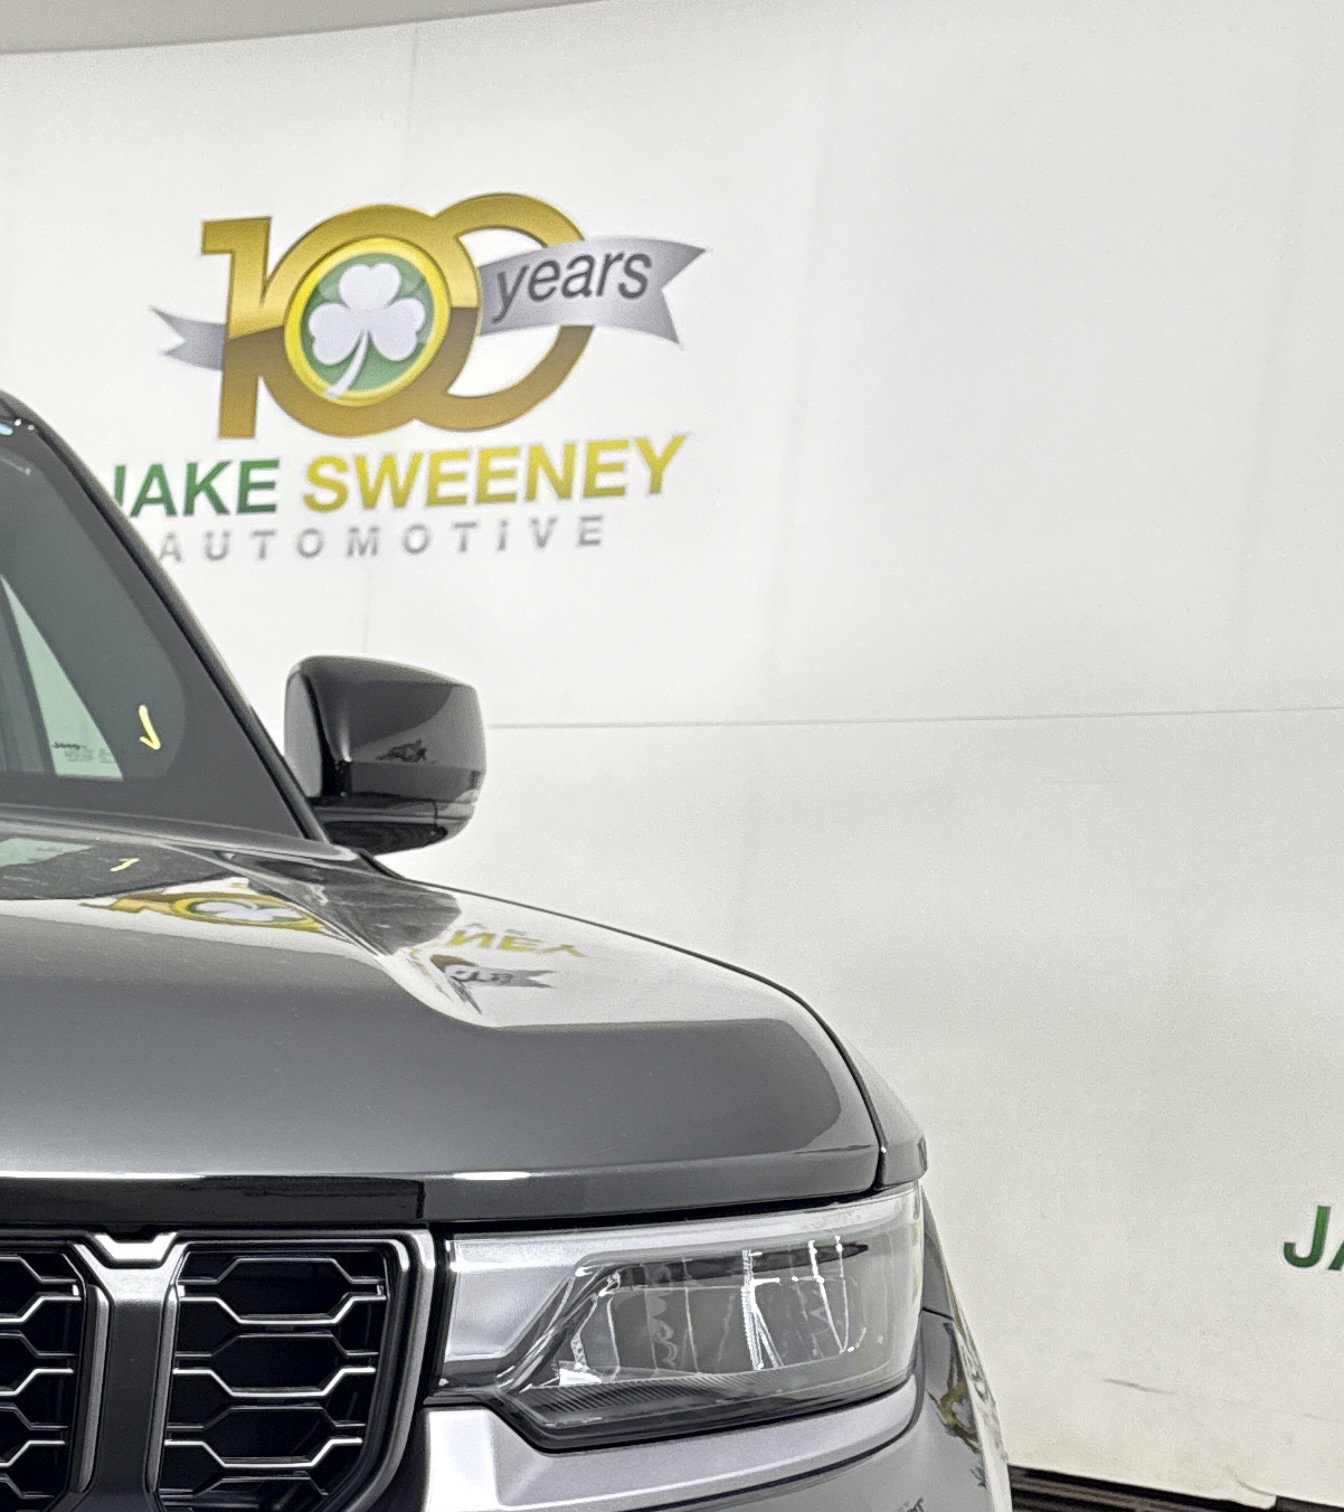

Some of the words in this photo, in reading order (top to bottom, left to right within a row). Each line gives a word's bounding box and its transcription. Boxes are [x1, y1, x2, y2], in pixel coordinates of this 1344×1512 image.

[201, 193, 595, 439] 100
[496, 250, 652, 322] years
[303, 435, 684, 512] SWEENEY
[159, 514, 605, 562] AUTOMOTIVE
